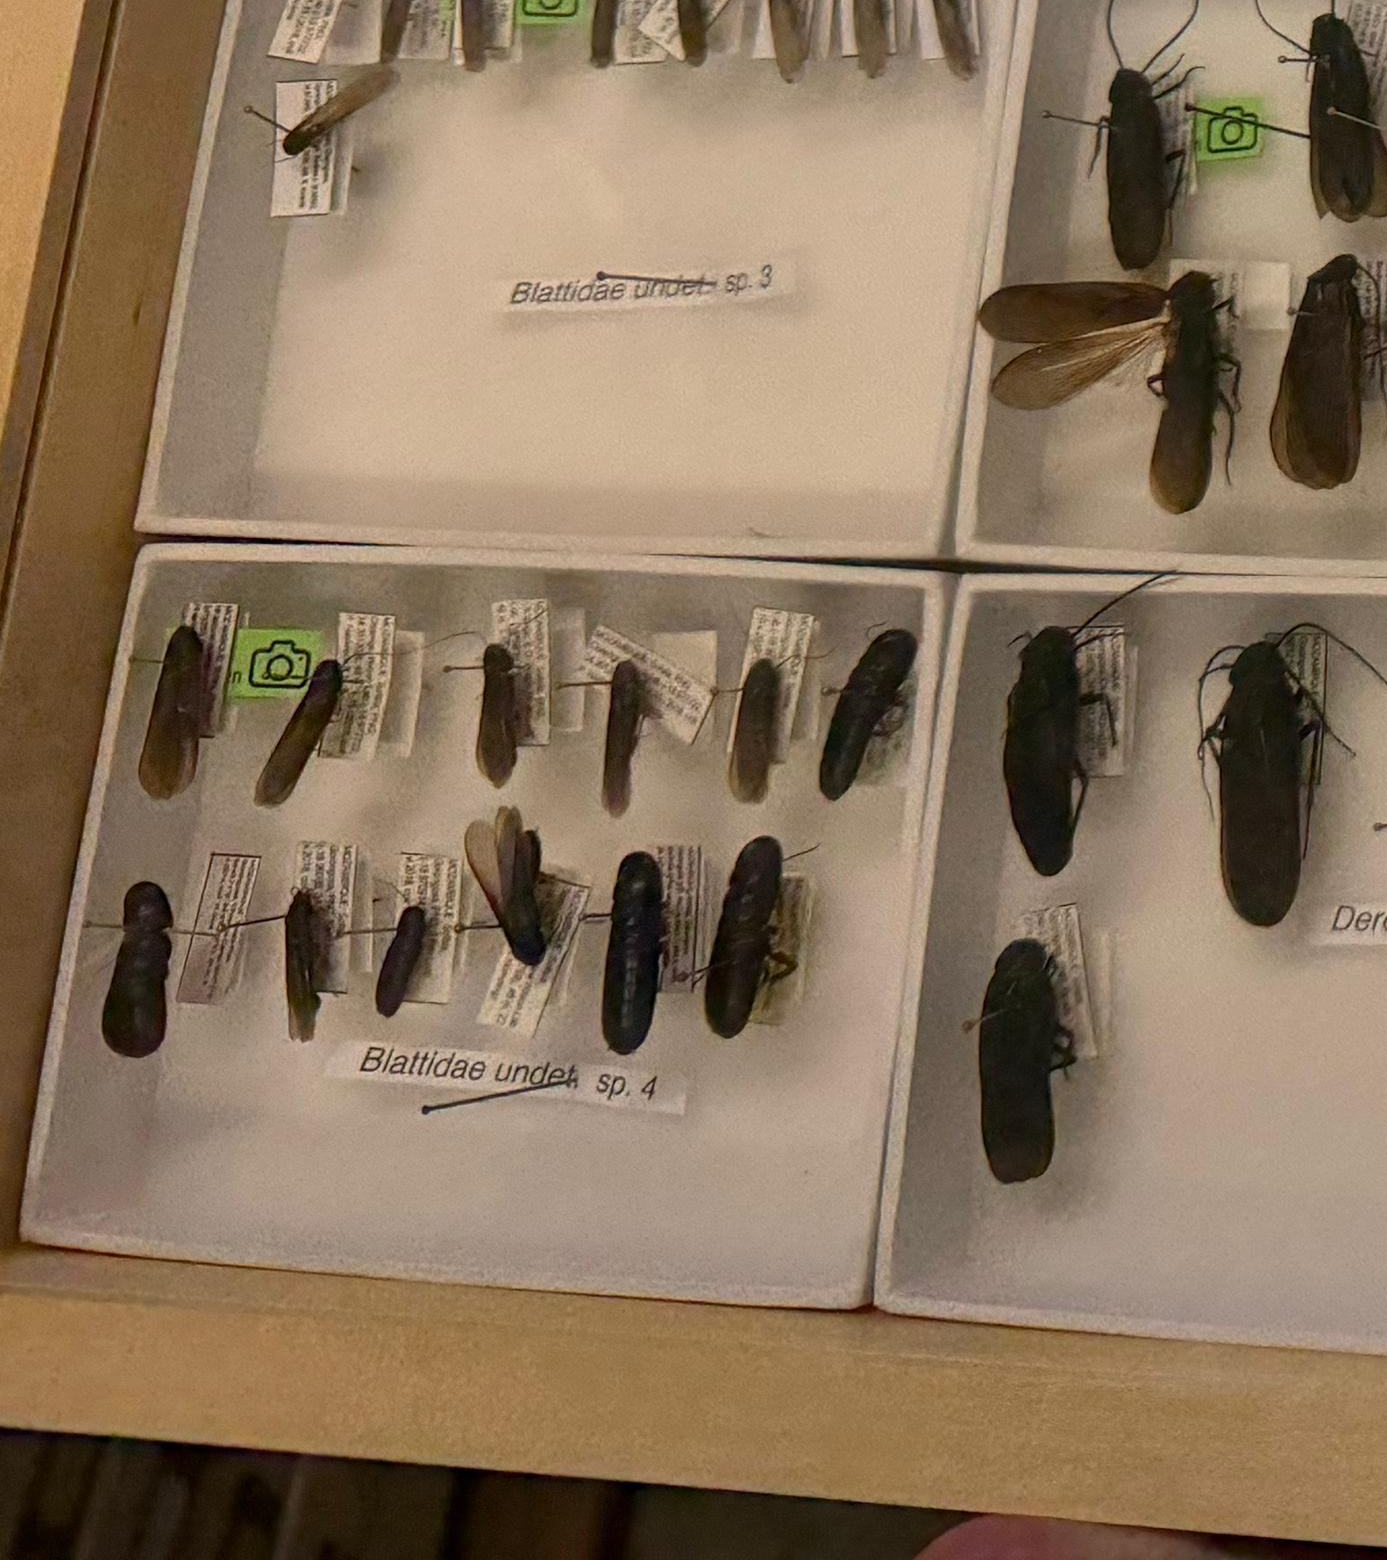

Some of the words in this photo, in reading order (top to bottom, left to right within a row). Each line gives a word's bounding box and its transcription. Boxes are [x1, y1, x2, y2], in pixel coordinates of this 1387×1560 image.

[510, 278, 626, 305] Blattidae
[724, 274, 752, 297] sp.
[759, 264, 774, 290] 3
[359, 1046, 485, 1081] Blattidae
[596, 1072, 631, 1102] sp.
[641, 1076, 658, 1100] 4
